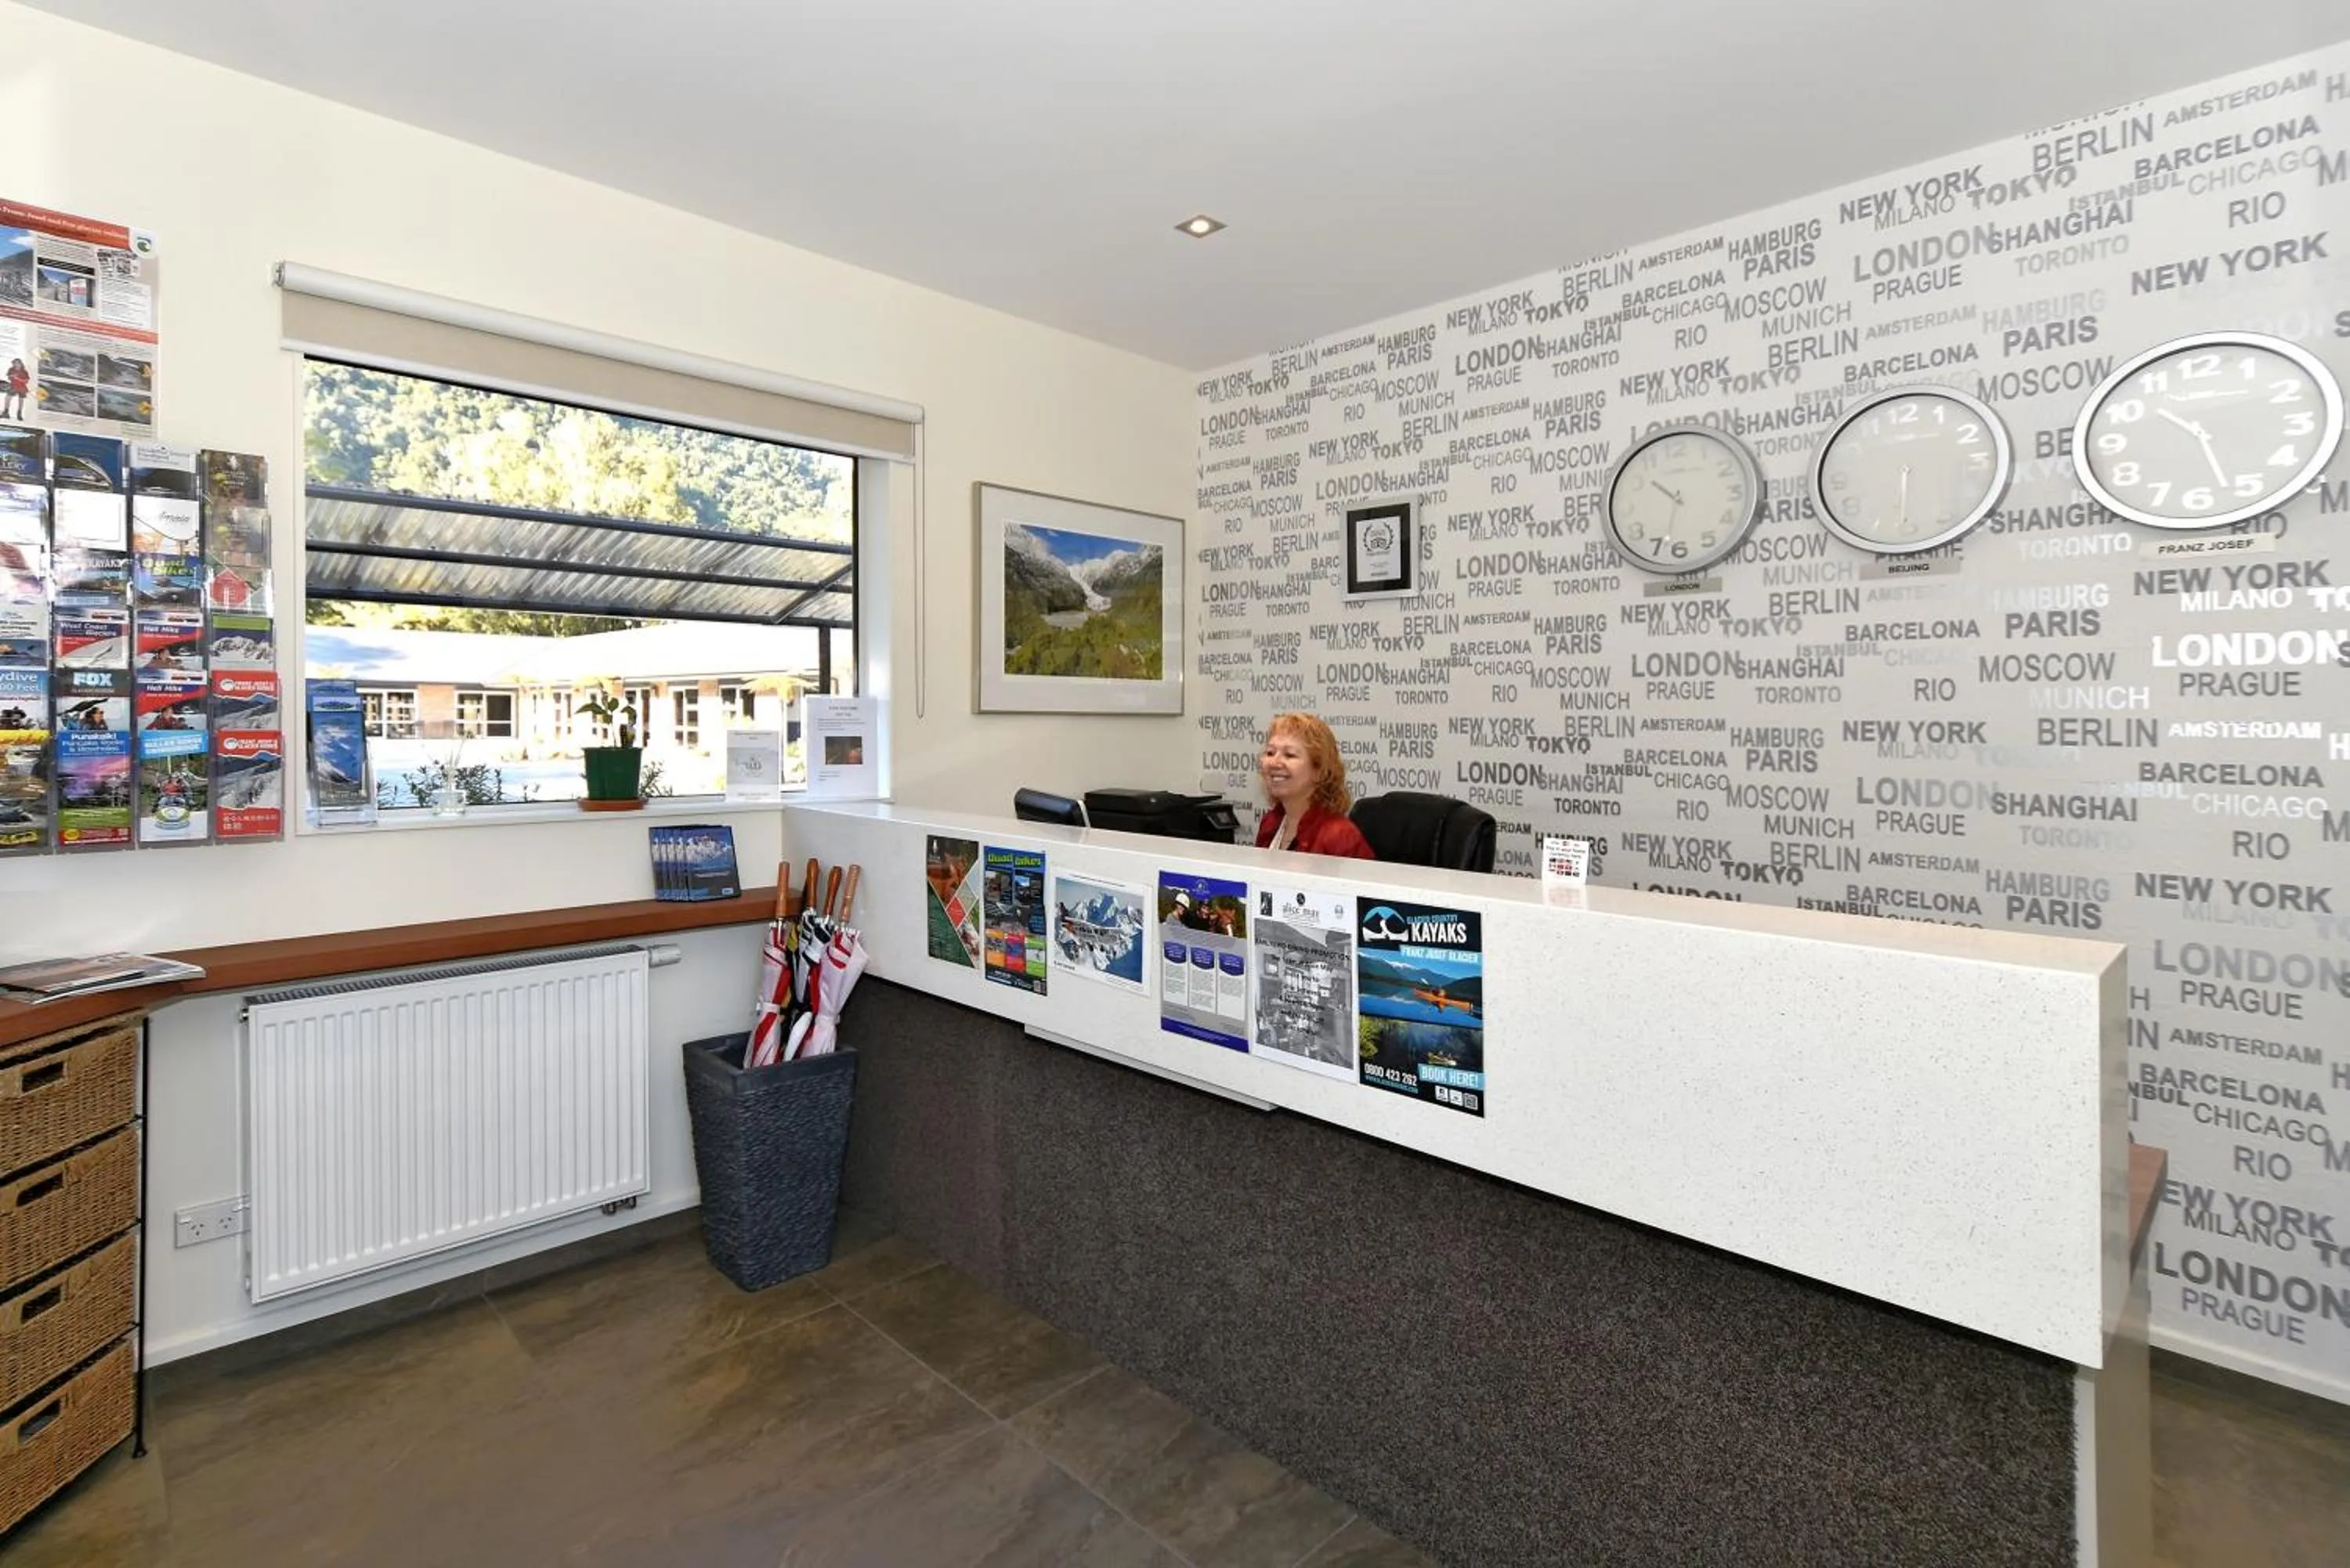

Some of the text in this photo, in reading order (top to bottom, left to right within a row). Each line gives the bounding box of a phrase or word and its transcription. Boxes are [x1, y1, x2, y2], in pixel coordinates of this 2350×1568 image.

[2161, 68, 2315, 126] AMSTERDAM
[2032, 113, 2152, 174] BERLIN
[2133, 114, 2316, 179] BARCELONA
[1838, 164, 1982, 223] NEW YORK
[1965, 161, 2075, 208] TOKYO
[2226, 189, 2284, 226] RIO
[1987, 194, 2132, 253] SHANGHAI
[1727, 216, 1820, 260] HAMBURG
[1852, 222, 1992, 282] LONDON
[1637, 235, 1723, 270] AMSTERDAM
[1743, 241, 1813, 280] PARIS
[2128, 231, 2326, 295] NEW YORK
[1622, 268, 1724, 309] BARCELONA
[1871, 262, 1960, 302] PRAGUE
[1447, 289, 1534, 329] NEW YORK
[1723, 275, 1825, 322] MOSCOW
[1379, 323, 1436, 353] HAMBURG
[1674, 322, 1706, 349] RIO
[1766, 327, 1856, 369] BERLIN
[2002, 314, 2096, 355] PARIS
[1272, 348, 1318, 378] BERLIN
[1388, 341, 1432, 369] PARIS
[1455, 334, 1539, 375] LONDON
[1842, 341, 1976, 383] BARCELONA
[2177, 355, 2223, 380] 12
[2239, 357, 2255, 380] 1
[1618, 356, 1730, 396] NEW YORK
[2139, 371, 2167, 395] 11
[2269, 379, 2302, 403] 2
[1201, 405, 1257, 435] LONDON
[1887, 403, 1919, 425] 12
[1932, 405, 1945, 424] 1
[2106, 399, 2145, 424] 10
[2283, 411, 2315, 435] 3
[1309, 428, 1379, 457] NEW YORK
[1449, 425, 1530, 454] BARCELONA
[1956, 424, 1980, 444] 2
[2098, 433, 2128, 456] 9
[2267, 445, 2300, 467] 4
[1316, 470, 1384, 500] LONDON
[2112, 462, 2141, 486] 8
[2234, 472, 2264, 497] 5
[2147, 482, 2171, 507] 7
[2182, 487, 2215, 510] 6
[1649, 537, 1664, 556] 7
[1671, 541, 1688, 558] 6
[1701, 530, 1716, 547] 5
[2158, 539, 2254, 555] FRANZ JOSEF
[1455, 550, 1540, 579] LONDON
[1888, 564, 1929, 573] BEIJING
[2131, 559, 2329, 595] NEW YORK
[1665, 582, 1700, 591] LONDON
[2178, 586, 2289, 611] MILANO
[1768, 587, 1858, 617] BERLIN
[1534, 612, 1607, 634] HAMBURG
[1844, 618, 1978, 642] BARCELONA
[2004, 609, 2098, 638] PARIS
[1261, 648, 1297, 664] PARIS
[1546, 633, 1601, 654] PARIS
[2149, 630, 2342, 667] LONDON
[1316, 663, 1384, 684] LONDON
[1530, 665, 1611, 688] MOSCOW
[1630, 651, 1737, 677] LONDON
[1734, 654, 1843, 679] SHANGHAI
[1976, 652, 2114, 681] MOSCOW
[73, 672, 113, 686] FOX
[1251, 674, 1303, 692] MOSCOW
[1646, 681, 1714, 699] PRAGUE
[1912, 676, 1955, 700] RIO
[2176, 670, 2298, 696] PRAGUE
[1560, 691, 1629, 709] MUNICH
[1379, 722, 1437, 740] HAMBURG
[1448, 717, 1535, 737] NEW YORK
[1840, 720, 1986, 746] NEW YORK
[2035, 718, 2157, 748] BERLIN
[2165, 721, 2319, 738] AMSTERDAM
[1526, 736, 1590, 754] TOKYO
[1623, 748, 1726, 766] BARCELONA
[1745, 748, 1817, 772] PARIS
[2137, 761, 2321, 786] BARCELONA
[1456, 761, 1541, 789] LONDON
[1654, 771, 1729, 791] CHICAGO
[1554, 798, 1621, 816] TORONTO
[1725, 782, 1828, 811] MOSCOW
[1854, 776, 1995, 812] LONDON
[1991, 790, 2136, 822] SHANGHAI
[2191, 792, 2326, 820] CHICAGO
[1676, 799, 1708, 821] RIO
[1875, 810, 1964, 836] PRAGUE
[1763, 814, 1853, 838] MUNICH
[1769, 842, 1860, 873] BERLIN
[2231, 829, 2290, 860] RIO
[1719, 861, 1802, 887] TOKYO
[1866, 851, 1979, 873] AMSTERDAM
[1845, 883, 1979, 915] BARCELONA
[2132, 873, 2331, 917] NEW YORK
[2005, 896, 2100, 930] PARIS
[1412, 923, 1467, 944] KAYAKS
[2151, 940, 2345, 997] LONDON
[2178, 981, 2301, 1021] PRAGUE
[2167, 1028, 2322, 1066] AMSTERDAM
[1421, 1066, 1480, 1088] BOOK HERE!
[2139, 1064, 2323, 1115] BARCELONA
[2193, 1103, 2329, 1150] CHICAGO
[2232, 1146, 2292, 1182] RIO
[2160, 1179, 2334, 1248] EW YORK
[2182, 1209, 2294, 1254] MILANO
[2153, 1245, 2347, 1329] LONDON
[2181, 1290, 2303, 1346] PRAGUE
